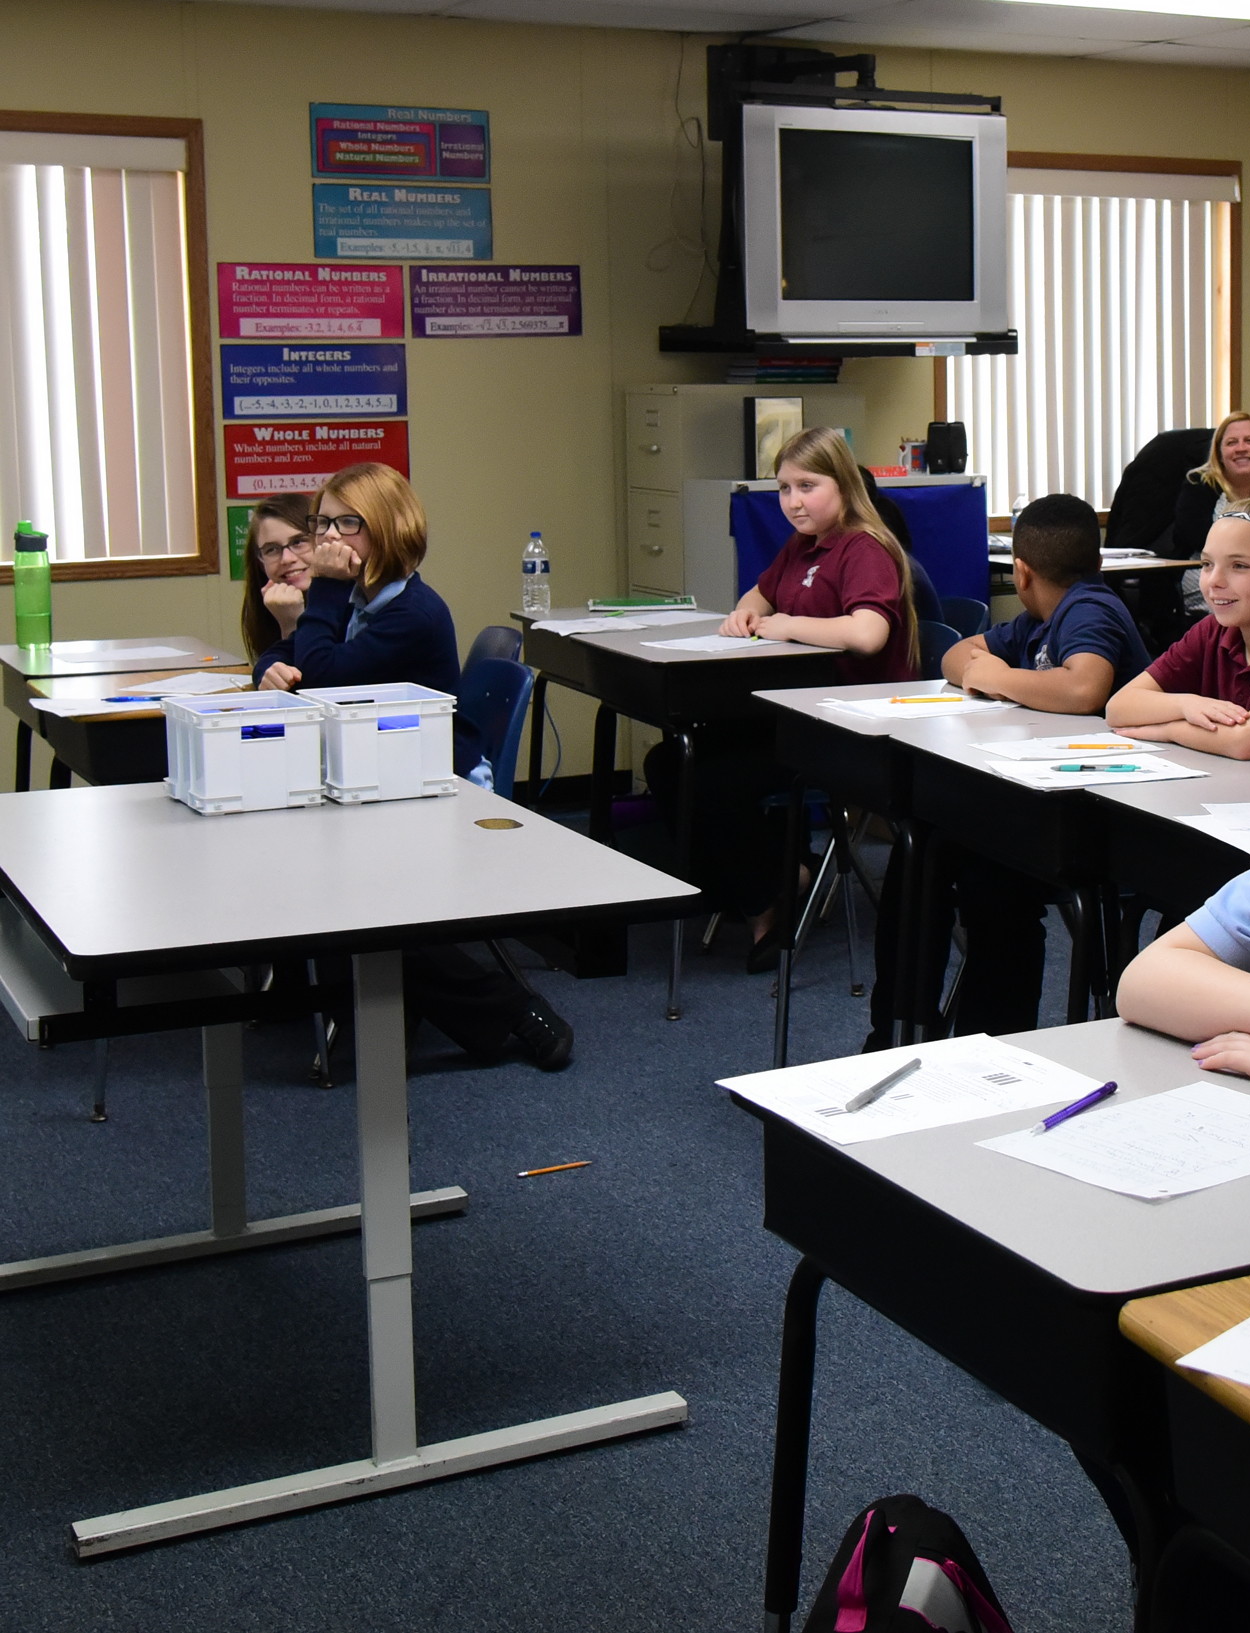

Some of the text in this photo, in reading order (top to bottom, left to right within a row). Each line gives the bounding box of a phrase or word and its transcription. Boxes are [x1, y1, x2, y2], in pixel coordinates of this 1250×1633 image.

[387, 108, 473, 122] Real Numbers
[333, 121, 420, 132] Rational Numbers
[357, 132, 397, 141] Integers
[339, 142, 415, 153] Whole Numbers
[441, 142, 484, 150] Irrational
[335, 152, 420, 163] Natural Numbers
[442, 151, 484, 161] Numbers
[349, 188, 461, 204] REAL NUMBERS
[318, 203, 338, 214] The
[353, 204, 364, 214] of
[367, 204, 377, 214] all
[380, 205, 414, 215] rational
[416, 206, 453, 216] numbers
[456, 207, 471, 216] and
[363, 217, 401, 227] numbers
[404, 218, 429, 228] makes
[235, 266, 387, 282] RATIONAL NUMBERS
[421, 268, 573, 282] IRRATIONAL NUMBERS
[232, 282, 270, 292] Rational
[272, 283, 310, 294] numbers
[311, 285, 327, 293] can
[328, 283, 340, 293] be
[342, 284, 371, 293] written
[414, 284, 427, 293] An
[429, 284, 466, 293] irrational
[468, 284, 498, 293] number
[500, 285, 526, 293] cannot
[528, 284, 538, 292] be
[540, 284, 567, 293] written
[272, 293, 282, 303] In
[283, 293, 318, 303] decimal
[320, 293, 344, 304] form,
[353, 294, 386, 304] rational
[457, 294, 466, 303] In
[468, 294, 500, 303] decimal
[536, 294, 572, 303] irrational
[233, 304, 267, 314] number
[269, 304, 314, 315] terminates
[414, 304, 446, 314] number
[448, 304, 466, 313] does
[468, 305, 481, 313] not
[483, 304, 521, 313] terminate
[255, 322, 301, 335] Examples:
[283, 348, 351, 361] INTEGERS
[230, 363, 398, 376] Integers include all whole numbers and
[230, 375, 297, 386] their opposites.
[253, 426, 385, 441] WHOLE NUMBERS
[234, 440, 381, 454] Whole numbers include all natural
[234, 453, 314, 464] numbers and zero.
